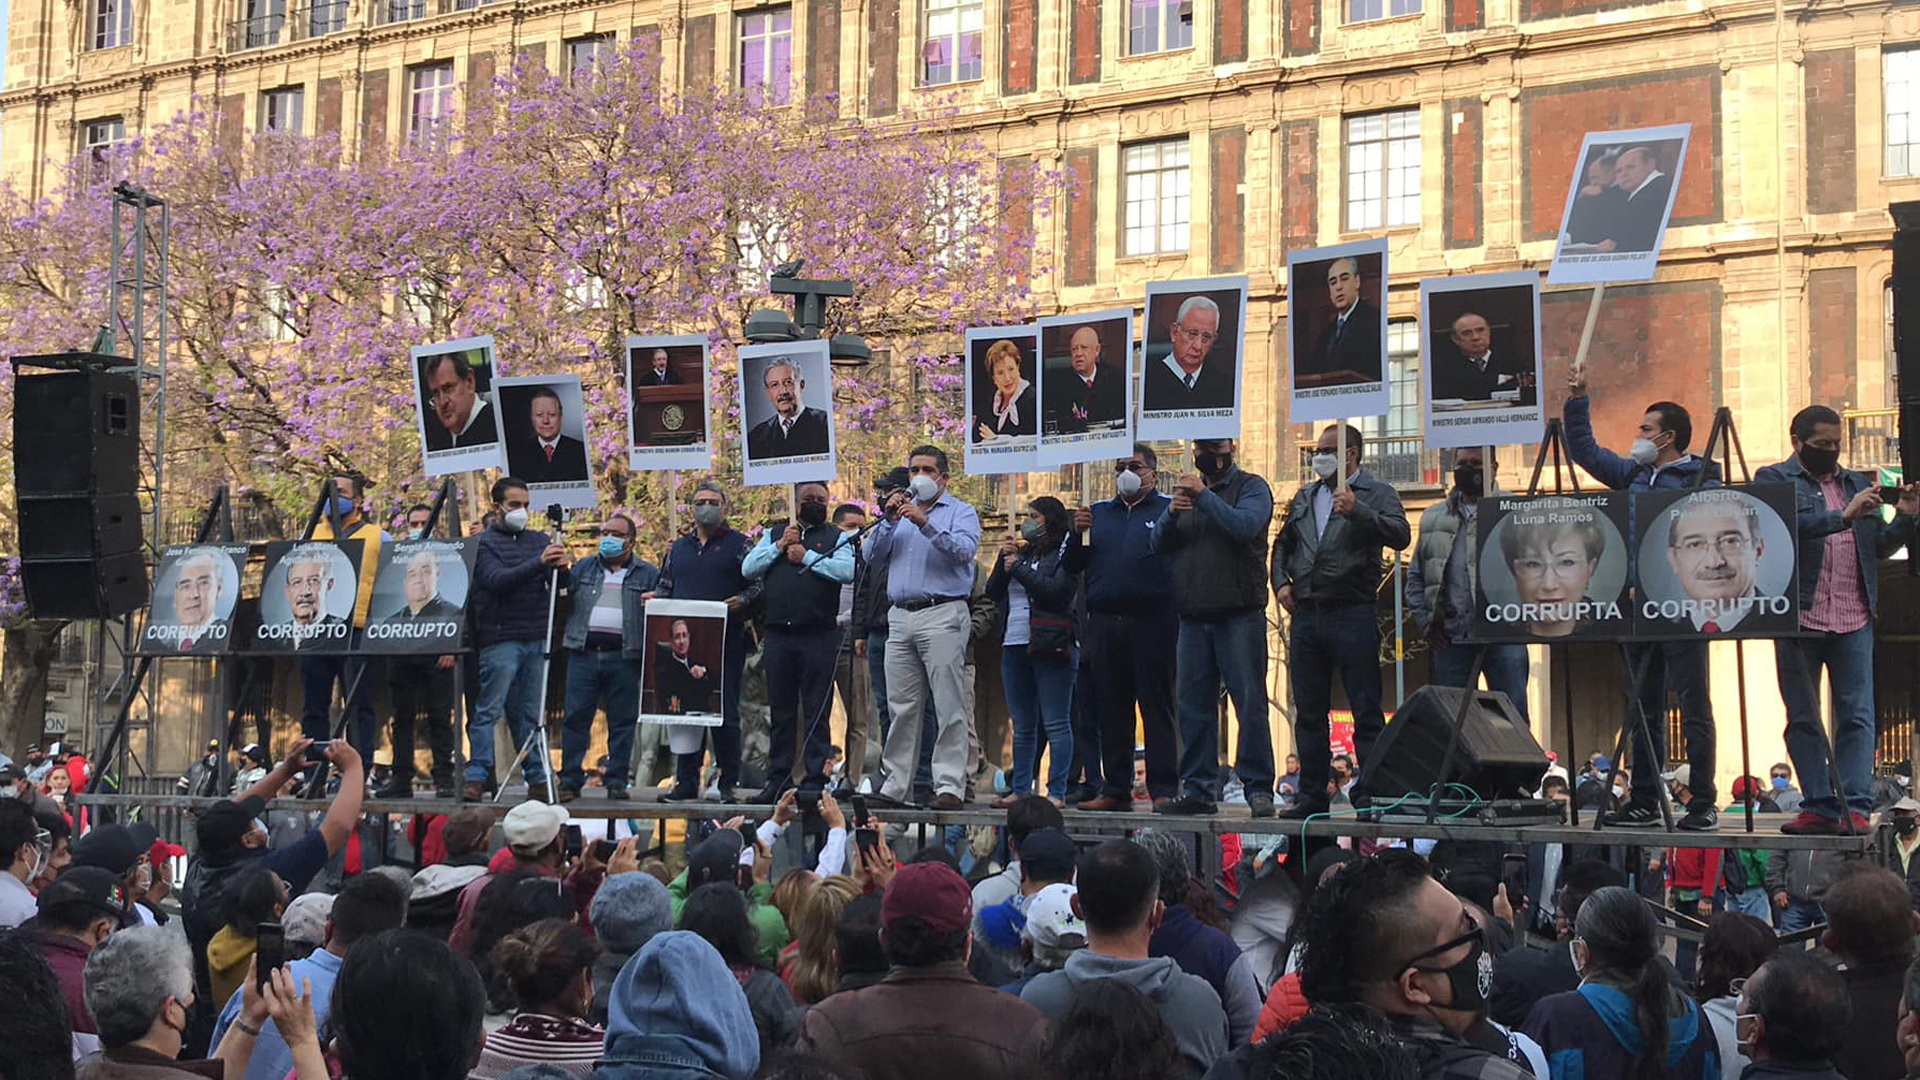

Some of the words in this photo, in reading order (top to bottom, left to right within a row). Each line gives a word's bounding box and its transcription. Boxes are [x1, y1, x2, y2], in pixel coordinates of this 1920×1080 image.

[1143, 411, 1172, 419] MINISTRO
[1197, 409, 1214, 417] SILVA
[1216, 409, 1233, 417] MEZA
[1500, 498, 1559, 511] Margarita
[1563, 495, 1608, 508] Beatriz
[1688, 491, 1740, 503] Alberto
[1513, 514, 1545, 525] Luna
[1549, 512, 1594, 523] Ramos
[393, 542, 422, 554] Sergio
[1485, 601, 1623, 622] CORRUPTA
[1642, 595, 1790, 619] CORRUPTO
[147, 624, 227, 640] CORRUPTO
[257, 623, 347, 639] CORRUPTO
[367, 622, 457, 639] CORRUPTO
